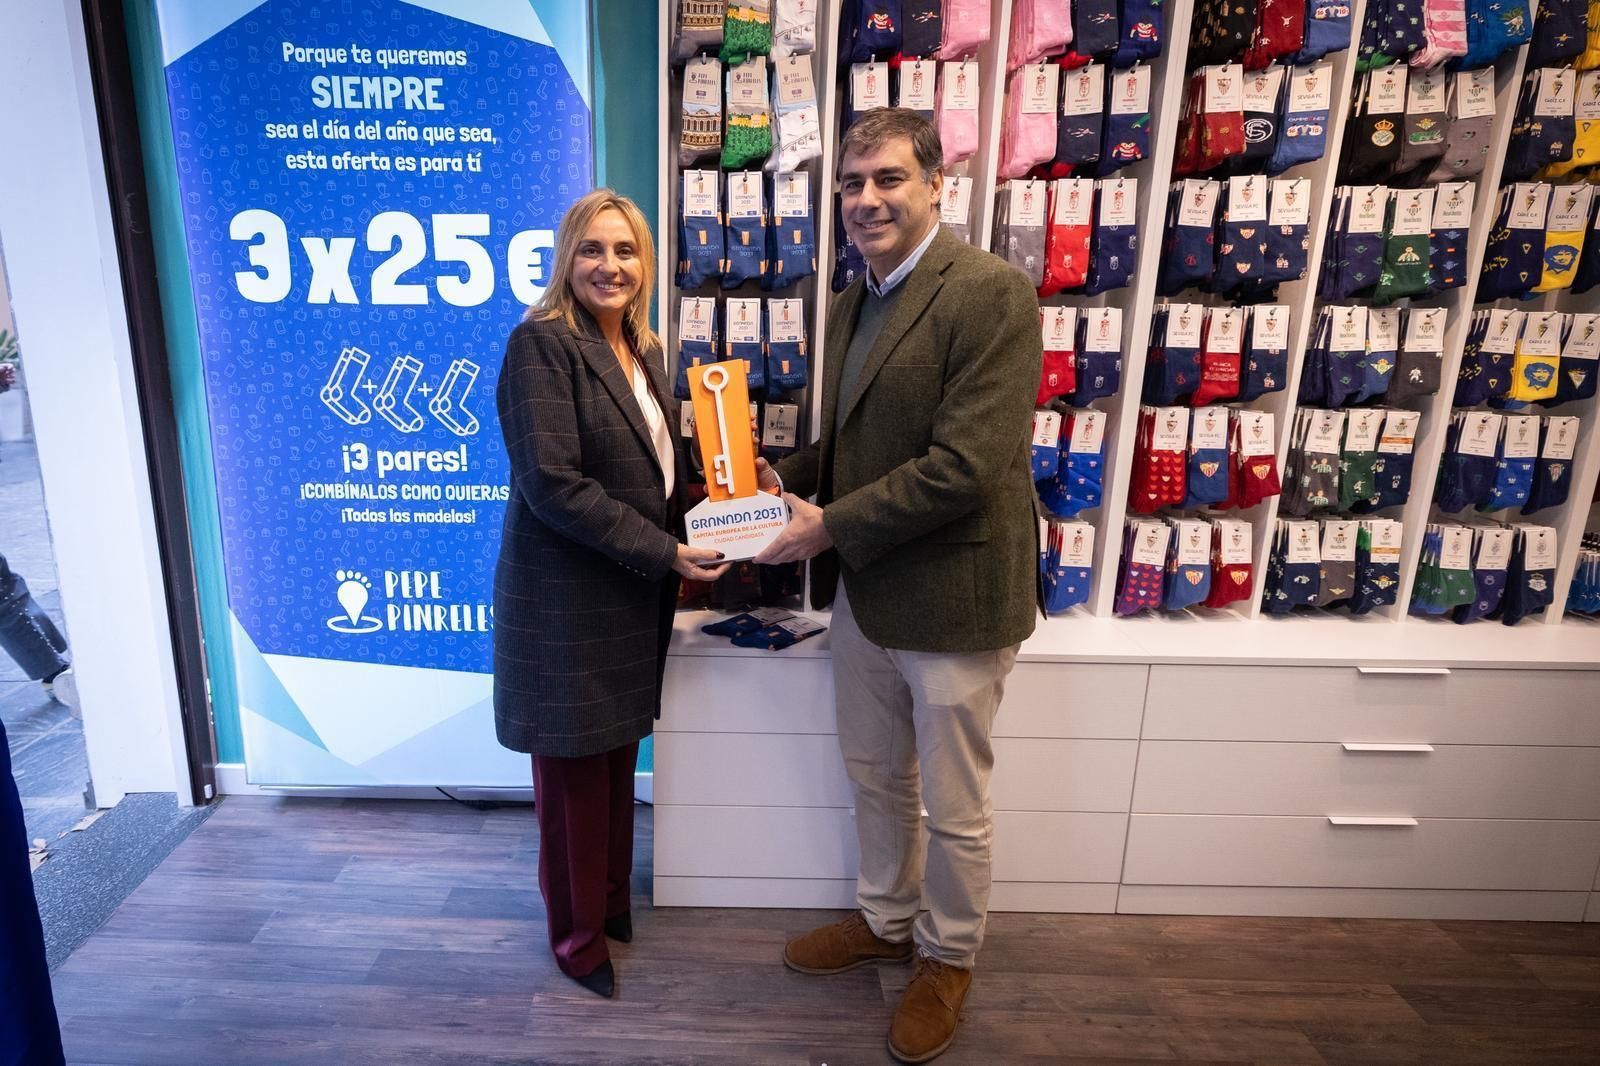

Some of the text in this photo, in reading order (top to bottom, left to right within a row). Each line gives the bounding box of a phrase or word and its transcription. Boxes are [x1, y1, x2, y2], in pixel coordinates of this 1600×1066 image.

[282, 42, 467, 68] Porque te queremos
[311, 75, 445, 110] SIEMPRE
[265, 119, 497, 147] sea el día del año que sea,
[286, 150, 482, 177] esta oferta es para tí
[342, 443, 468, 479] ¡3 pares!
[300, 482, 510, 501] ¡COMBÍNALOS COMO QUIERAS
[341, 507, 476, 524] ¡Todos los modelos!
[691, 506, 782, 530] GRANADA 2031
[692, 531, 716, 540] CAPITAL
[716, 527, 741, 536] EUROPEA
[758, 521, 783, 530] CULTURA
[714, 536, 735, 544] CIUDAD
[384, 570, 442, 599] PEPE
[386, 603, 494, 632] PINRELE
